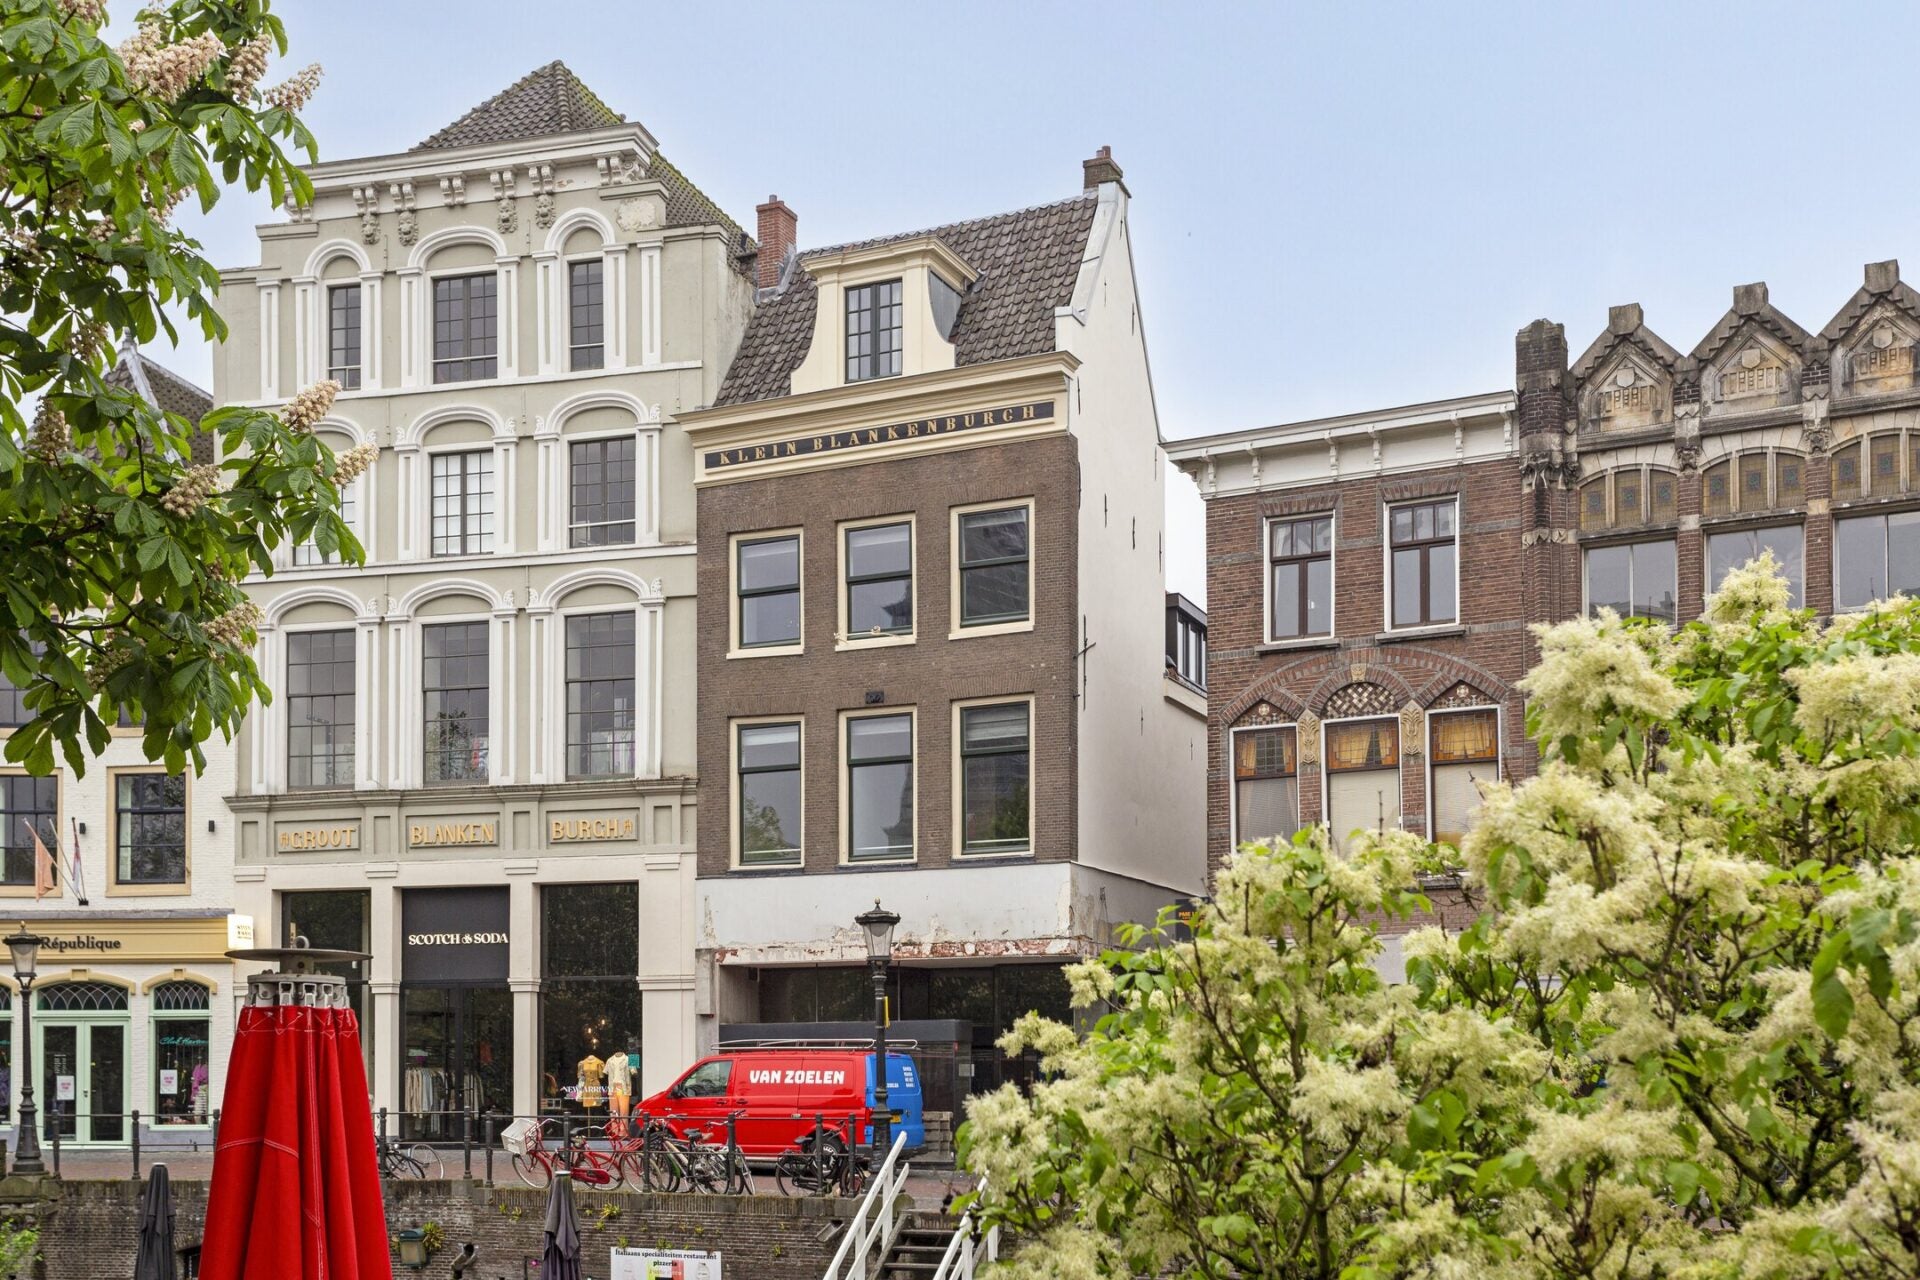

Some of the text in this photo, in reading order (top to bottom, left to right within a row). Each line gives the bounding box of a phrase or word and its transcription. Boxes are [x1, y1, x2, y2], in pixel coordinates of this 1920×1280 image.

[719, 405, 1036, 466] KLEIN BLANKENBURGH
[290, 827, 356, 849] GROOT
[410, 824, 494, 845] BLANKEN
[40, 936, 121, 952] République
[408, 932, 509, 945] SCOTCH & SODA
[749, 1069, 845, 1084] VAN ZOELEN
[615, 1248, 717, 1260] Italiaans specialiteiten restaurant
